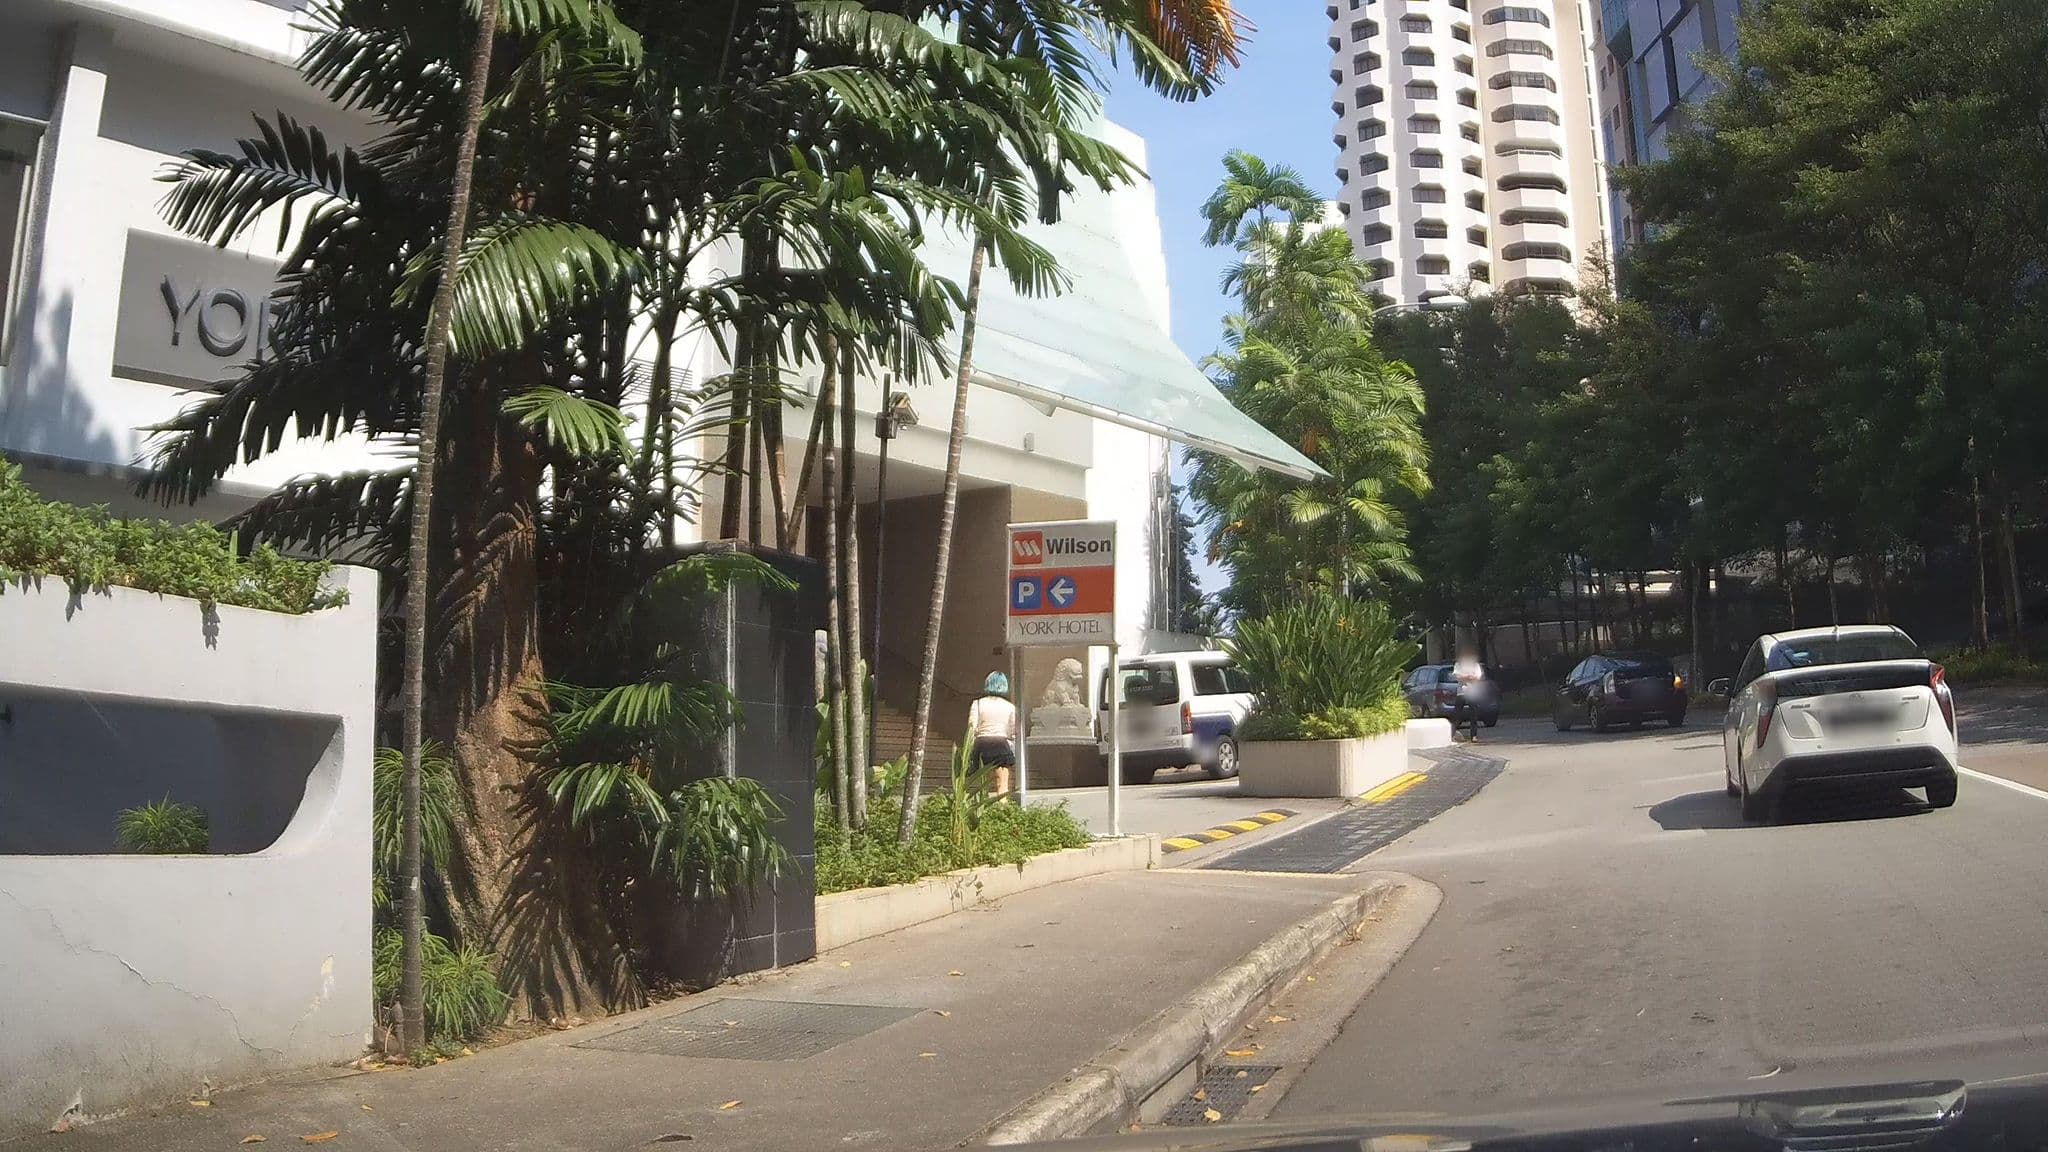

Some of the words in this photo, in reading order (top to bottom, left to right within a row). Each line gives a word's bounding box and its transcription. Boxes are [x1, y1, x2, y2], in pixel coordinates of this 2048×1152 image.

[1046, 537, 1112, 555] Wilson
[1018, 581, 1035, 603] P
[1019, 621, 1054, 635] YORK
[1058, 620, 1103, 634] HOTEL
